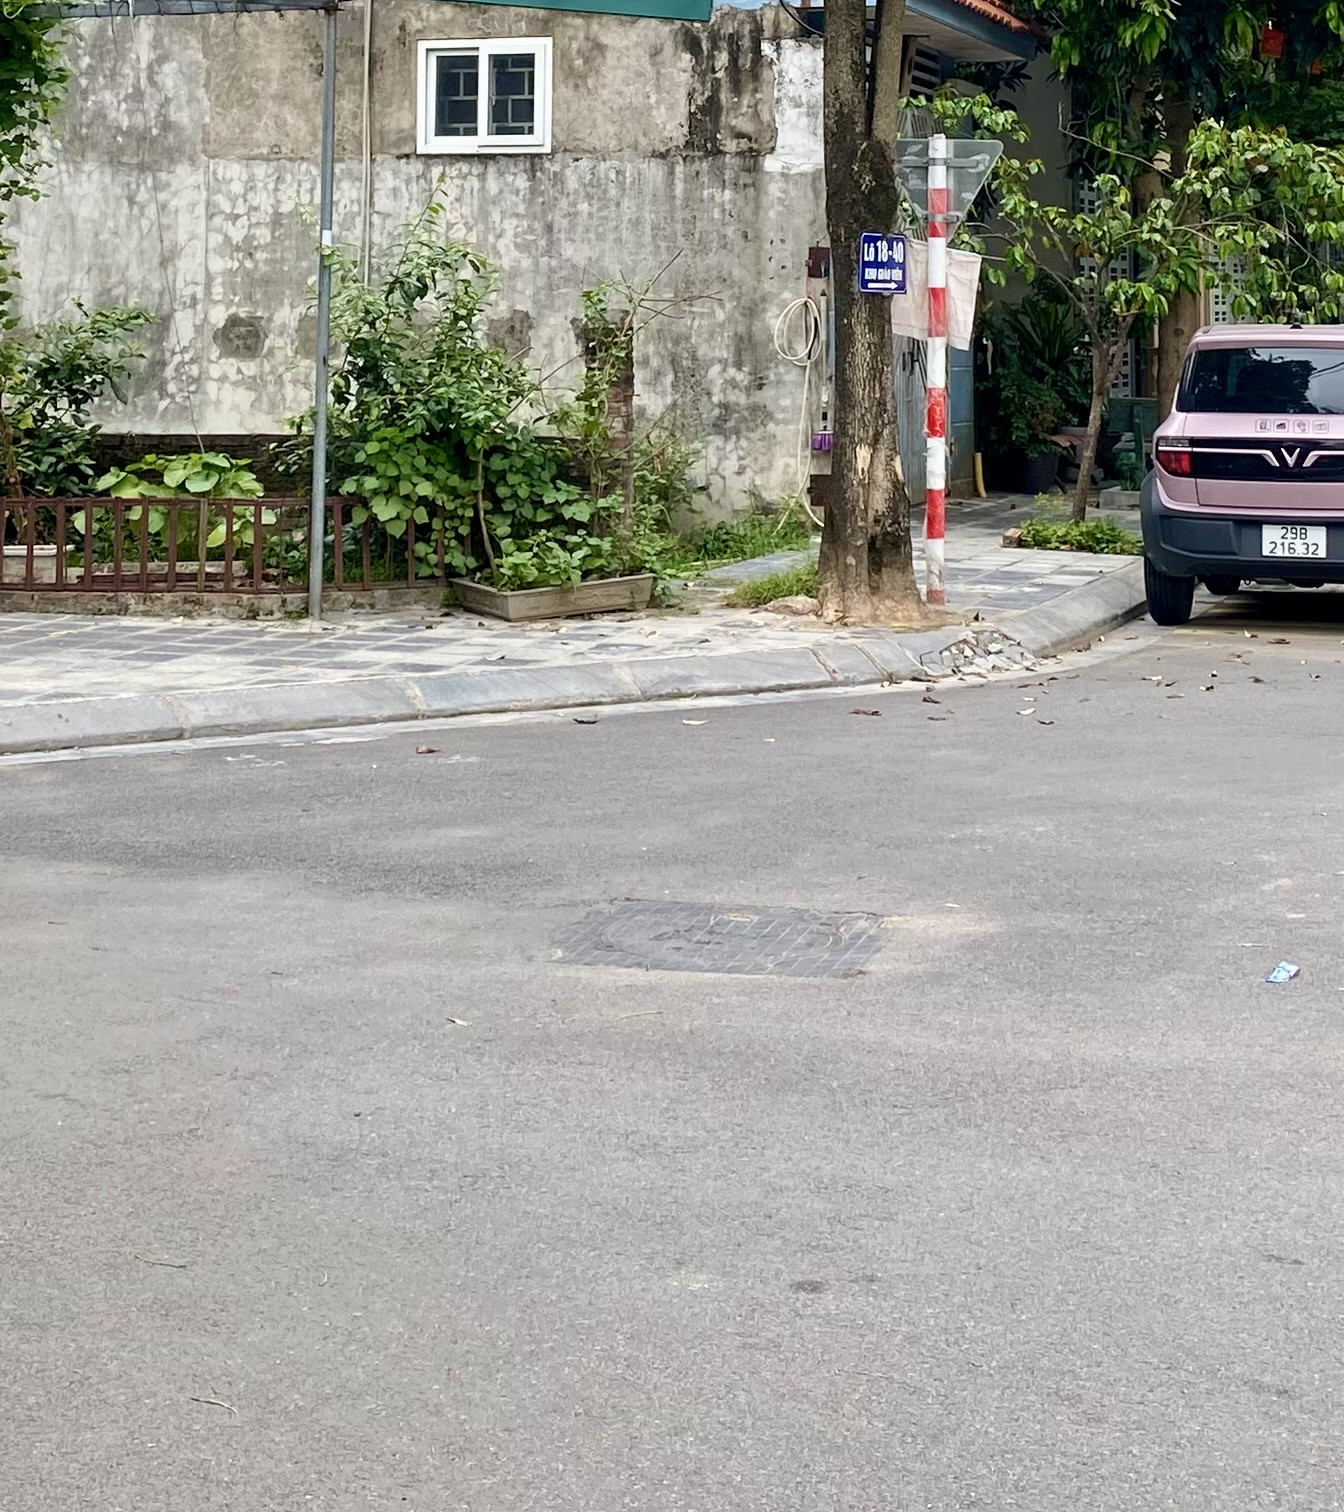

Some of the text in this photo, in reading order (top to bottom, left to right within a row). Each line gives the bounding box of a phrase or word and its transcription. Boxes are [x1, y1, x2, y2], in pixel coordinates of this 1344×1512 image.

[864, 240, 904, 263] Lô 18-40
[1280, 526, 1308, 541] 29B
[1268, 541, 1320, 556] 216.32
